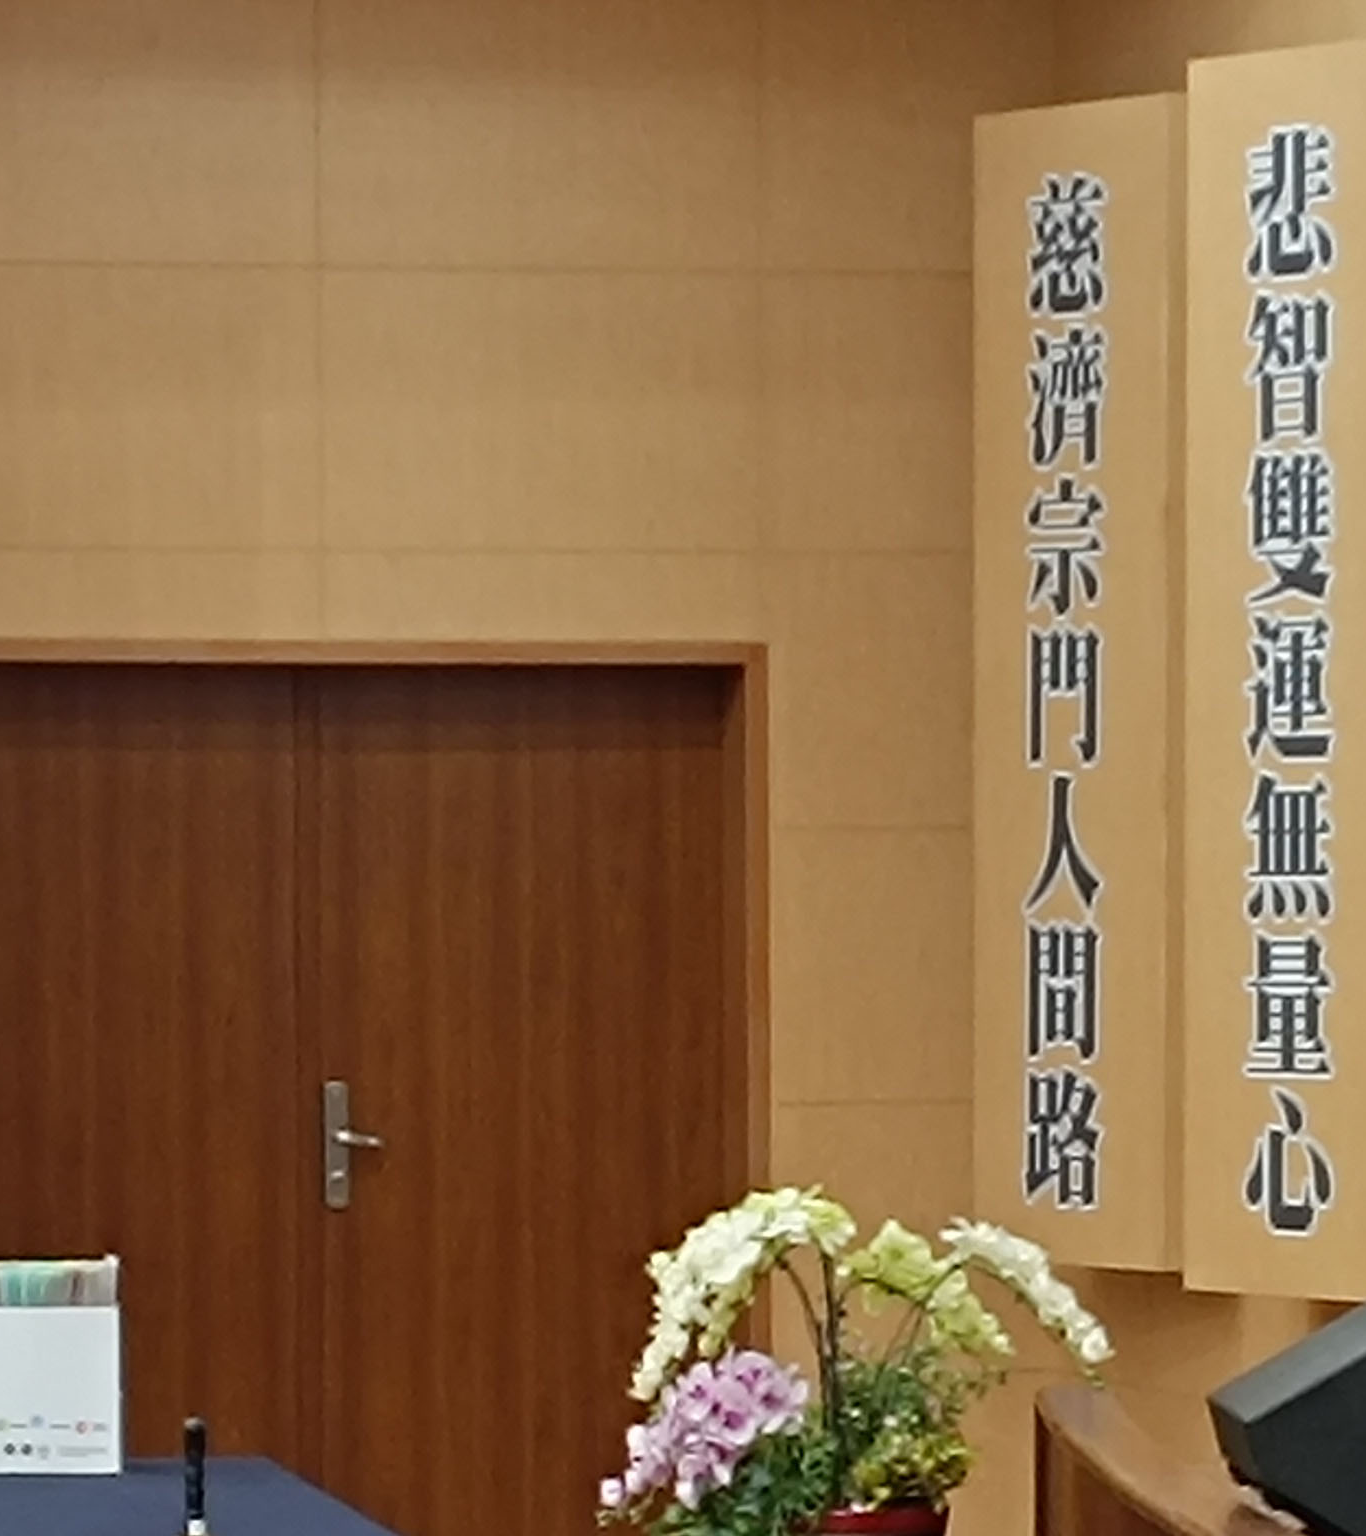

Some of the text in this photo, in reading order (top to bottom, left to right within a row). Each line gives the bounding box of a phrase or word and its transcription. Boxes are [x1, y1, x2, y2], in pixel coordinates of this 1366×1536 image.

[1023, 172, 1109, 1210] 慈濟宗門人間路
[1242, 123, 1336, 1236] 悲智雙運無量心
